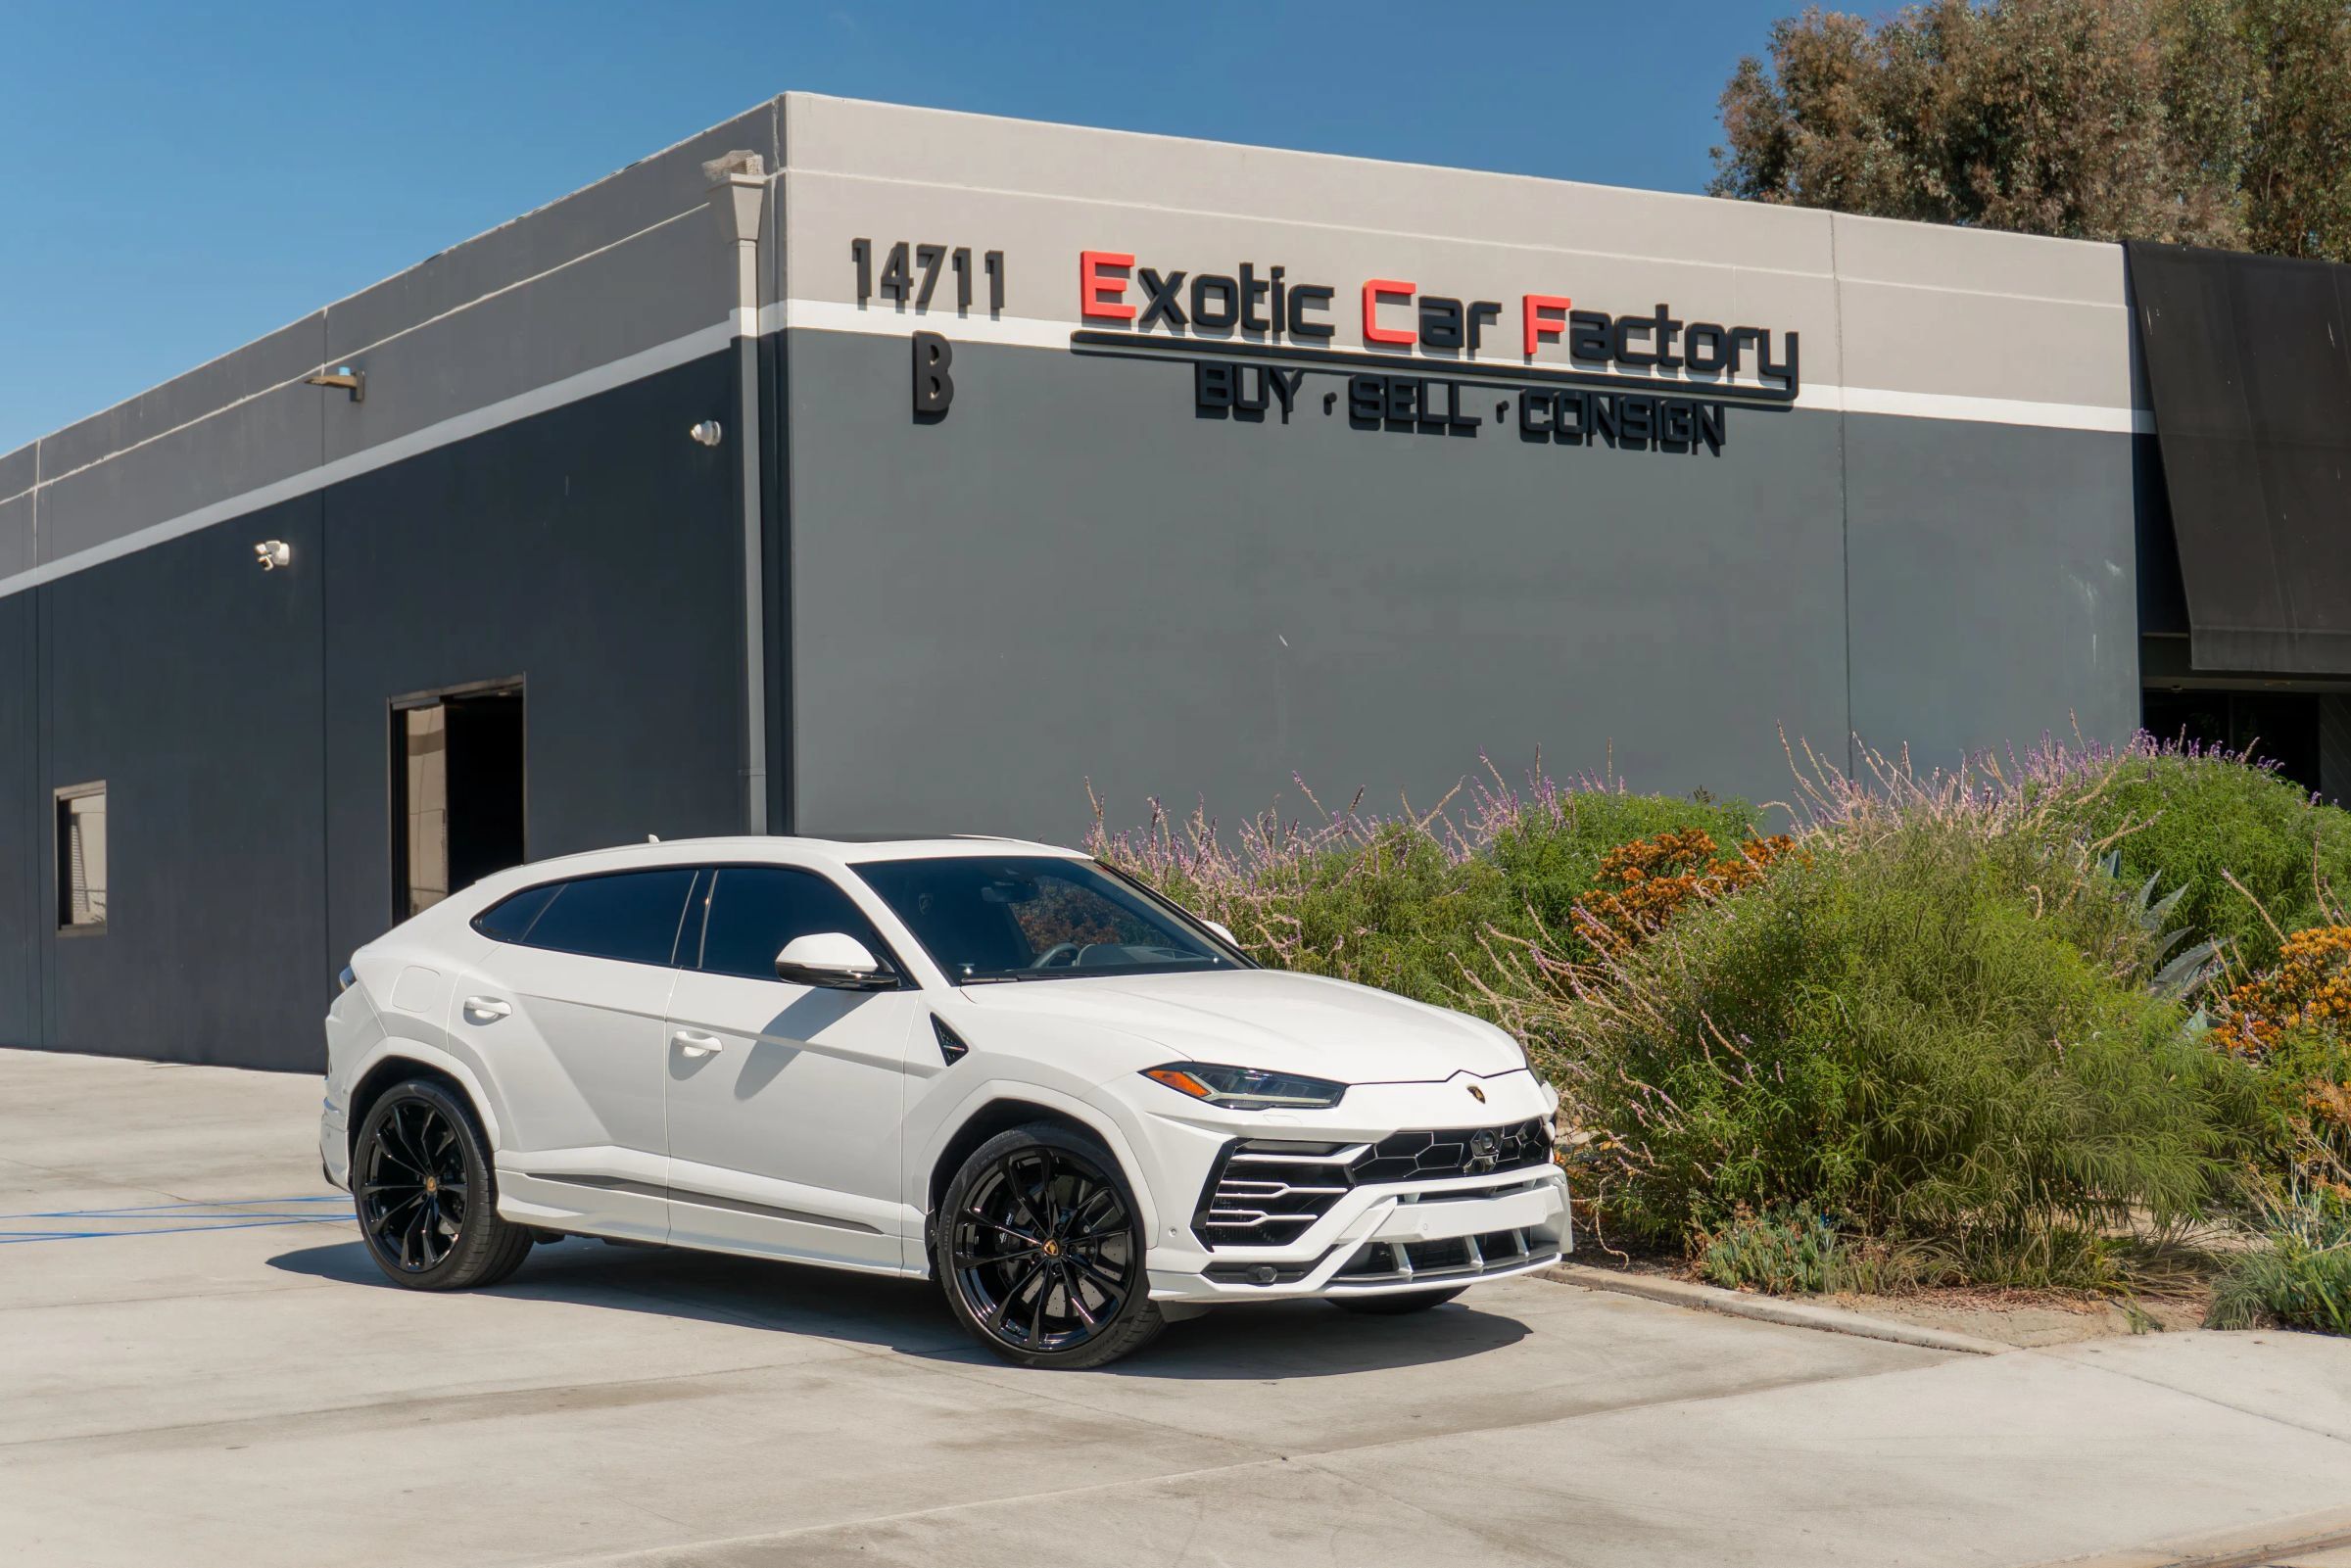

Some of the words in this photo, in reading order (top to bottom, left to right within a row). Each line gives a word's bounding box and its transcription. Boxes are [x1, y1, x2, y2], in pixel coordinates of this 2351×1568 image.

[851, 238, 1005, 309] 14711
[1080, 250, 1335, 338] Exotic
[1362, 278, 1502, 351] Car
[1522, 294, 1799, 401] Factory
[912, 330, 954, 413] B
[1195, 360, 1305, 413] BUY
[1348, 374, 1482, 428] SELL
[1519, 389, 1726, 447] CONSIGN
